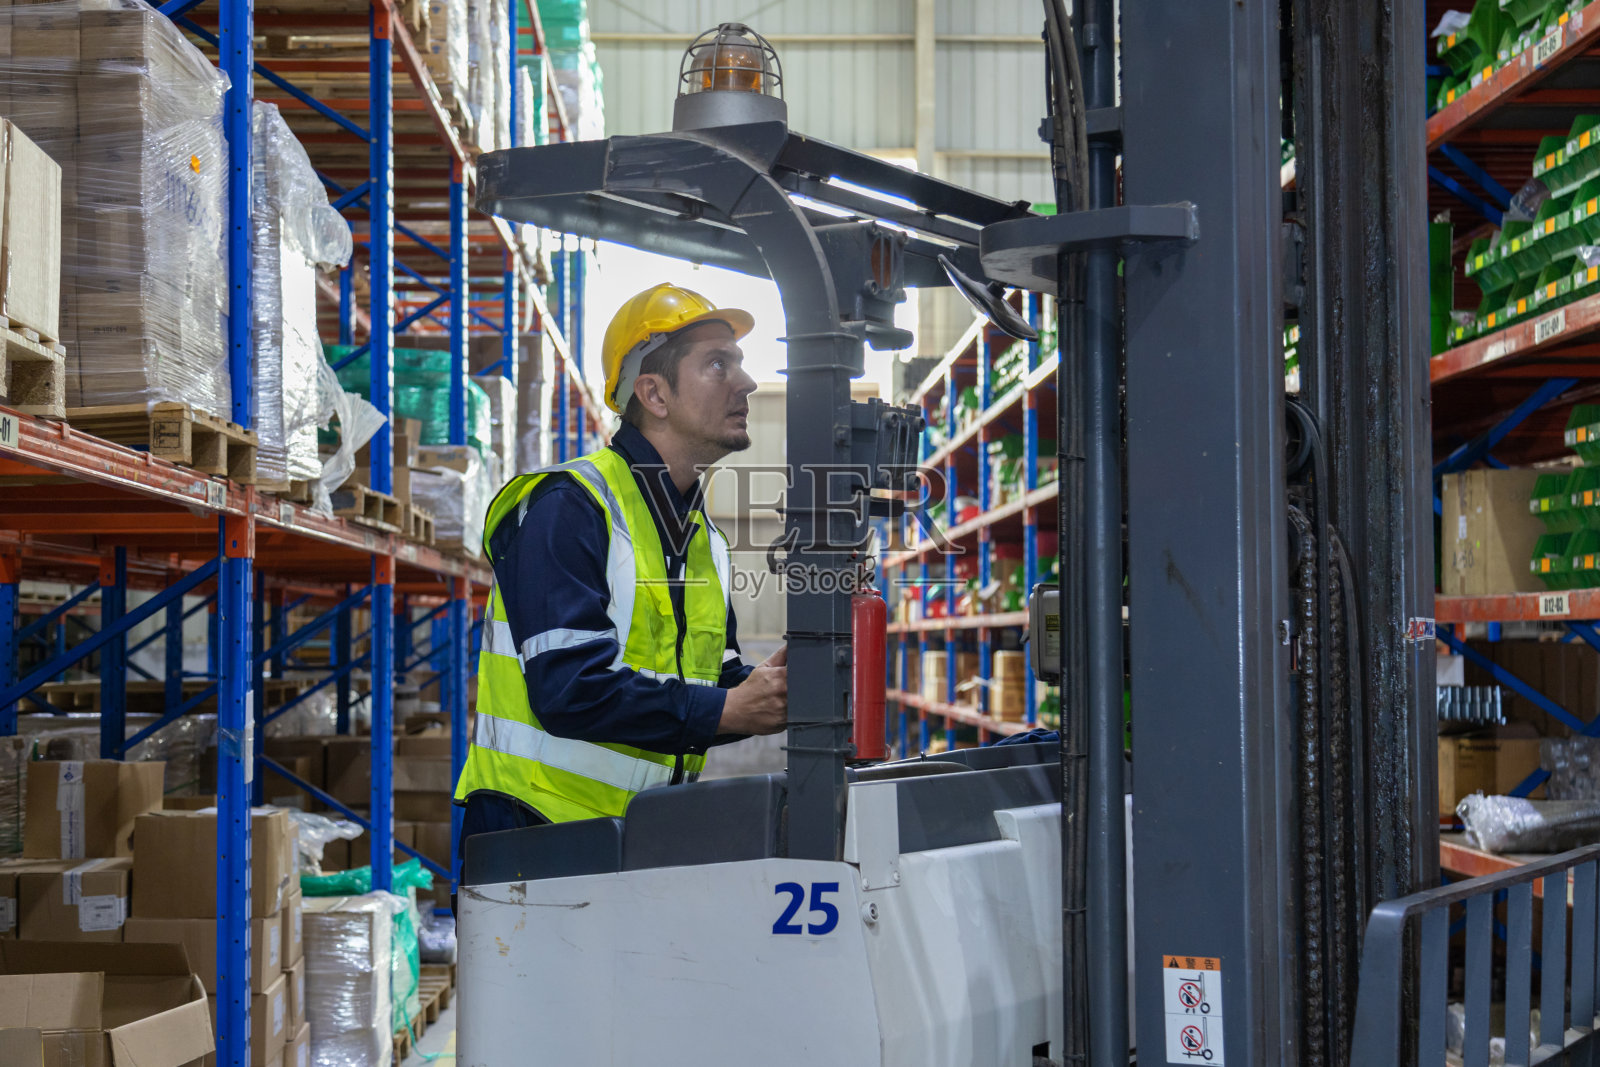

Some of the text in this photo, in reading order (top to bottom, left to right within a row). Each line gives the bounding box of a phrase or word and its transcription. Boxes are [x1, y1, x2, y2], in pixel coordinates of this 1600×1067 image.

[1538, 35, 1556, 60] D12-05
[1544, 597, 1564, 613] D12-03
[772, 882, 839, 935] 25
[1186, 958, 1214, 970] 警告
